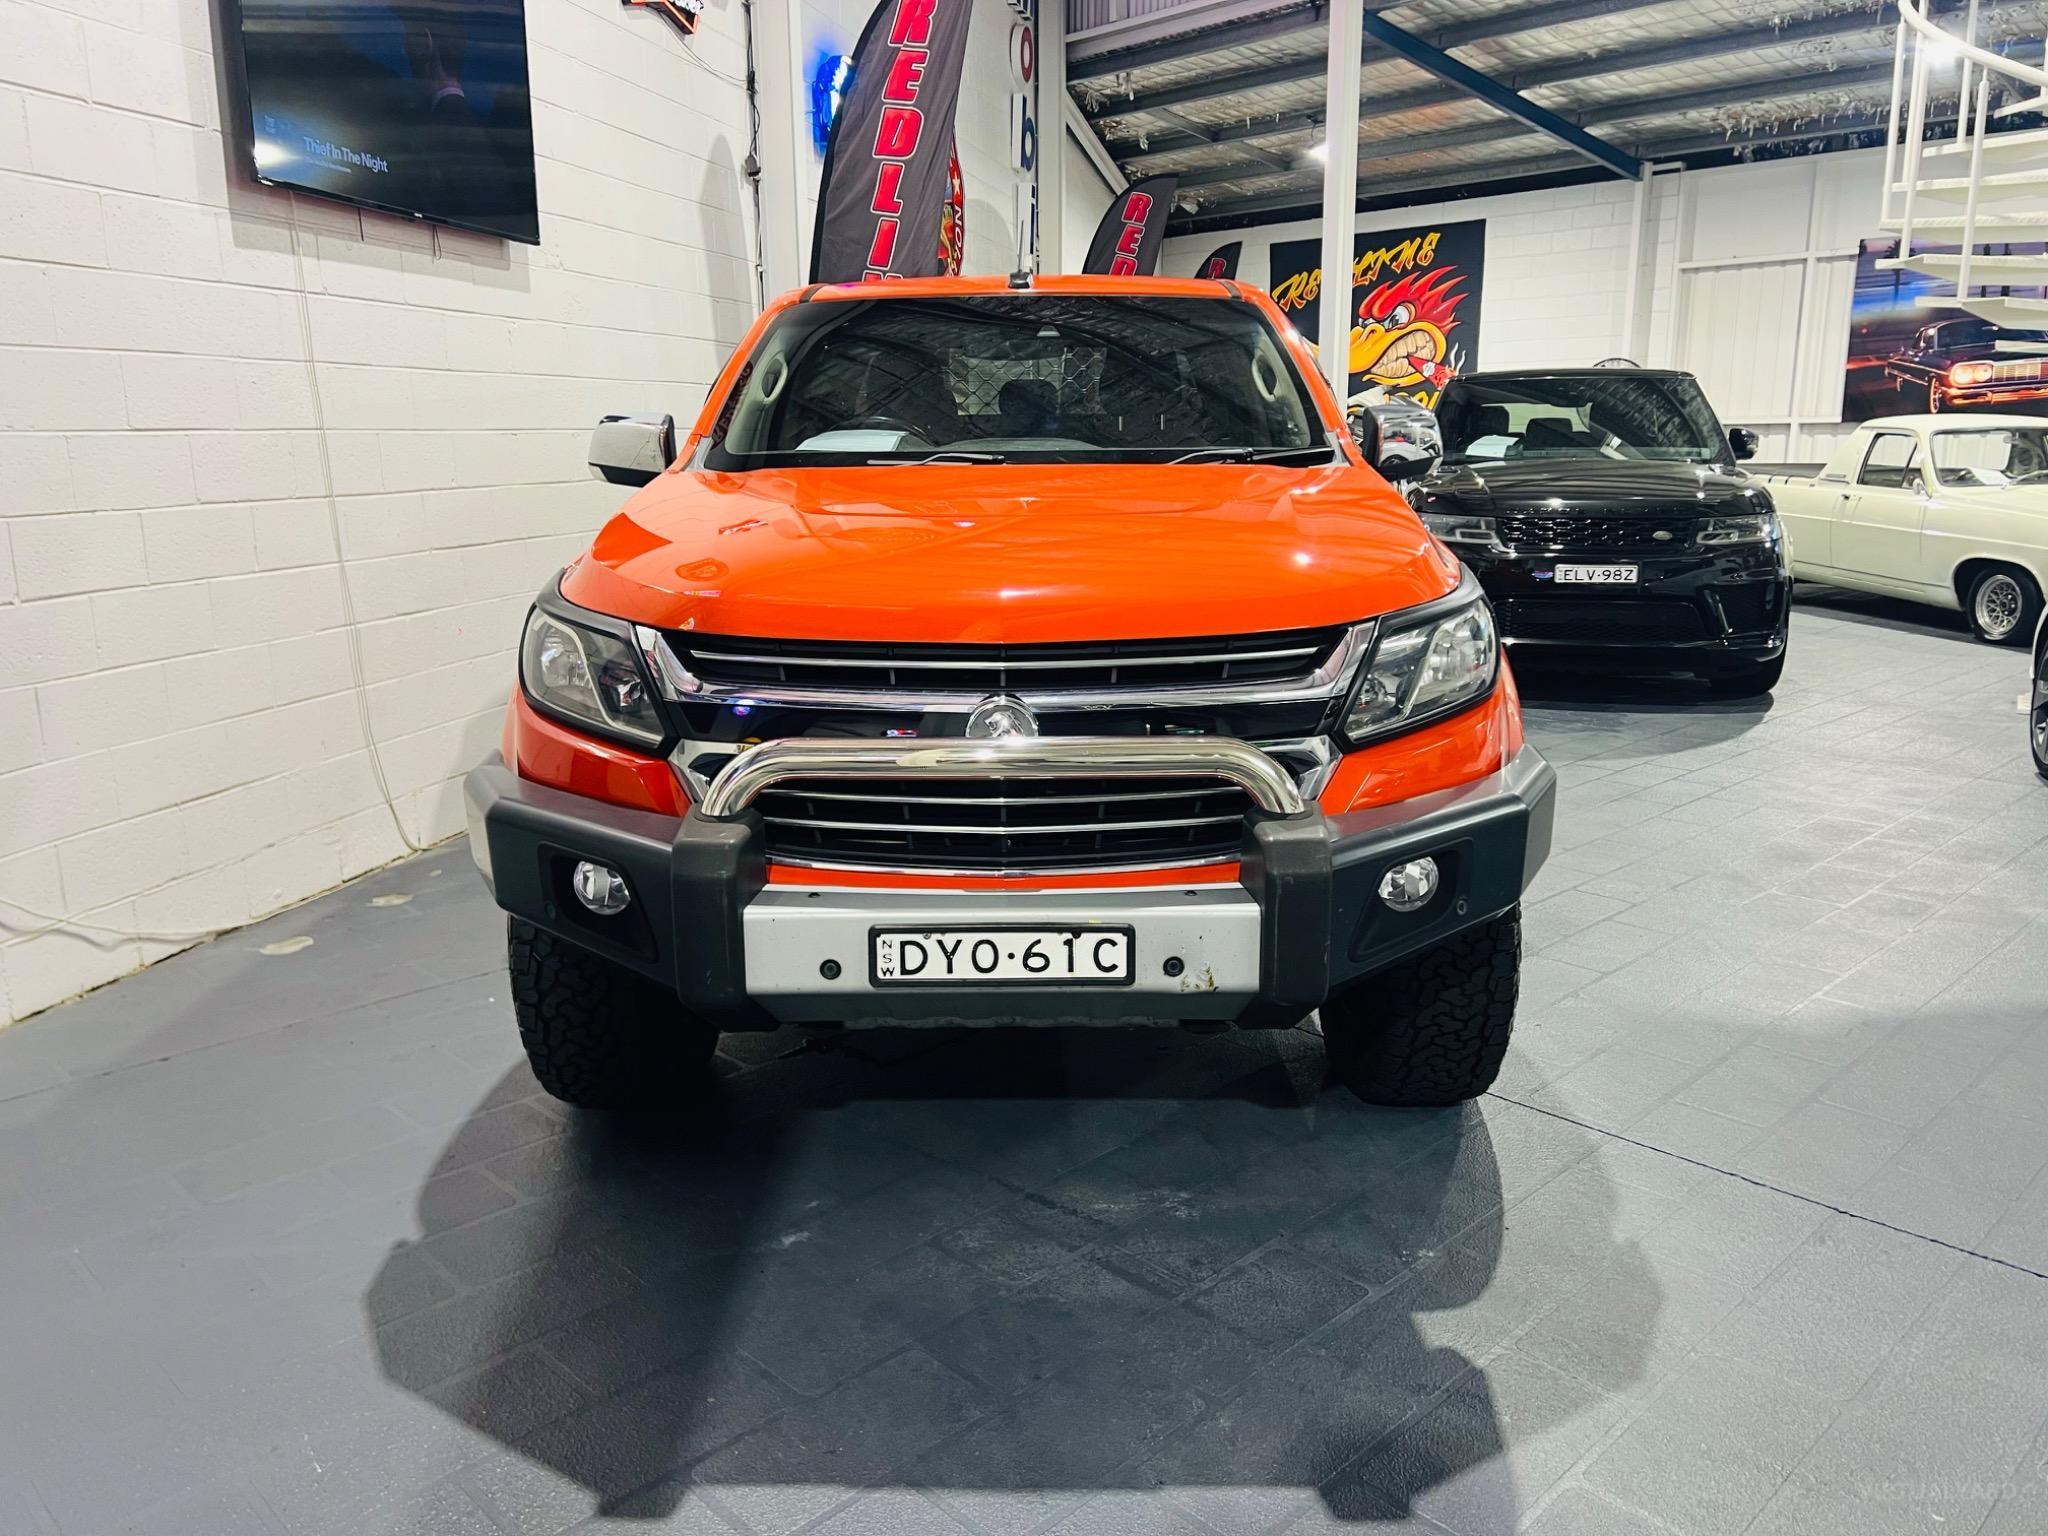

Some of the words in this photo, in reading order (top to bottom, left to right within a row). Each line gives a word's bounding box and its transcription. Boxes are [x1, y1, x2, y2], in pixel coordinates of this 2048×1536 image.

[303, 136, 331, 156] Thief
[332, 144, 342, 160] In
[342, 147, 362, 165] The
[361, 151, 389, 173] Night
[862, 0, 938, 281] REDLI
[1271, 231, 1441, 312] RELINE
